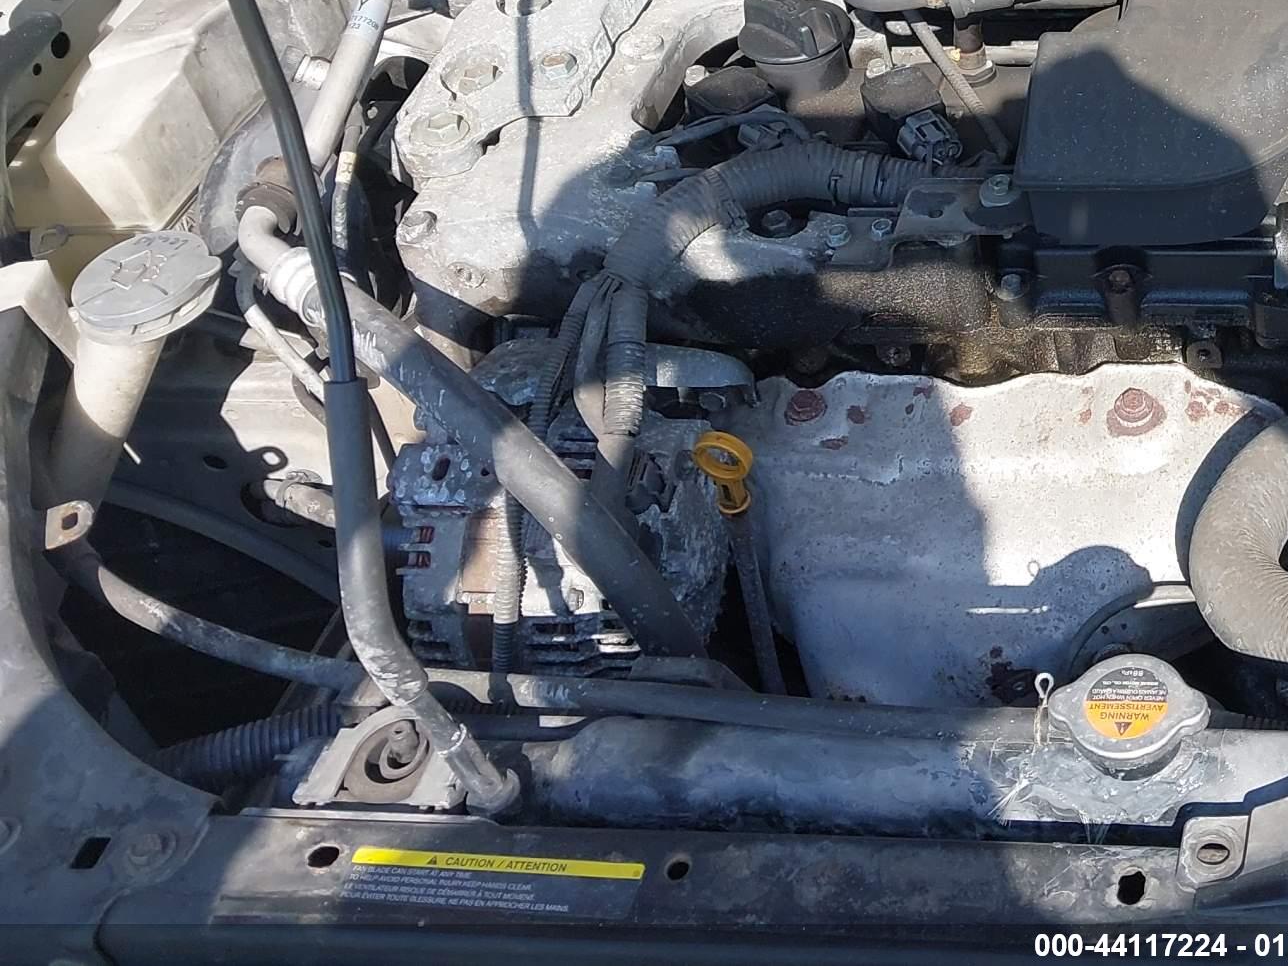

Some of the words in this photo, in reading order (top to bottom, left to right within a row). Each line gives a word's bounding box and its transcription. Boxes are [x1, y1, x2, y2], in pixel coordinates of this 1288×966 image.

[1088, 703, 1164, 712] AVERTISSEMENT
[1100, 712, 1149, 721] WARNING
[445, 857, 495, 867] CAUTION
[507, 861, 568, 872] ATTENTION
